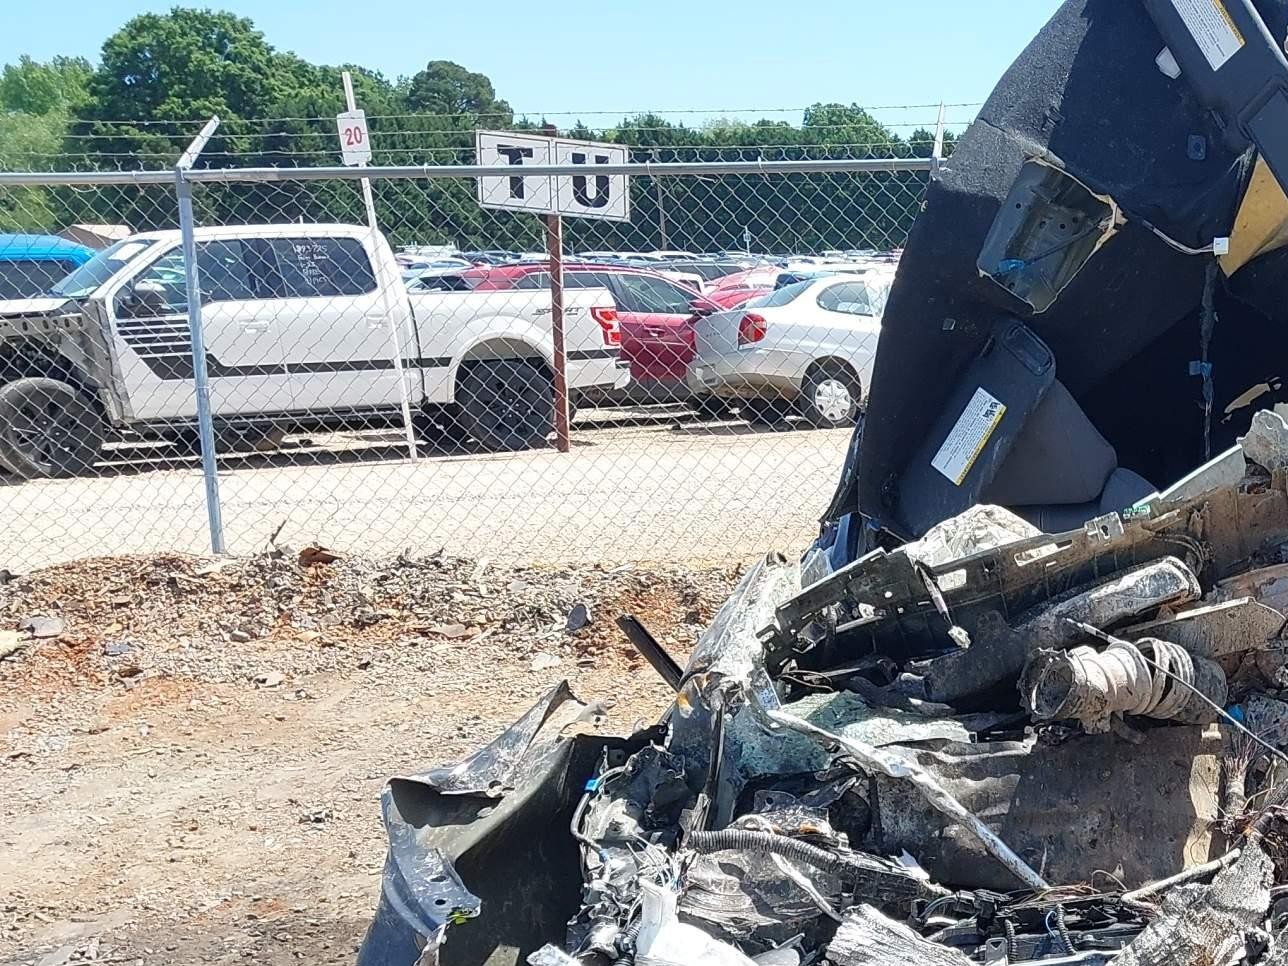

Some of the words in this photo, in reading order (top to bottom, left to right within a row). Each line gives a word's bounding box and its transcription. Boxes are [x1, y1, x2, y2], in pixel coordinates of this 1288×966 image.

[345, 126, 363, 146] 20
[496, 144, 534, 200] T
[571, 152, 610, 208] U
